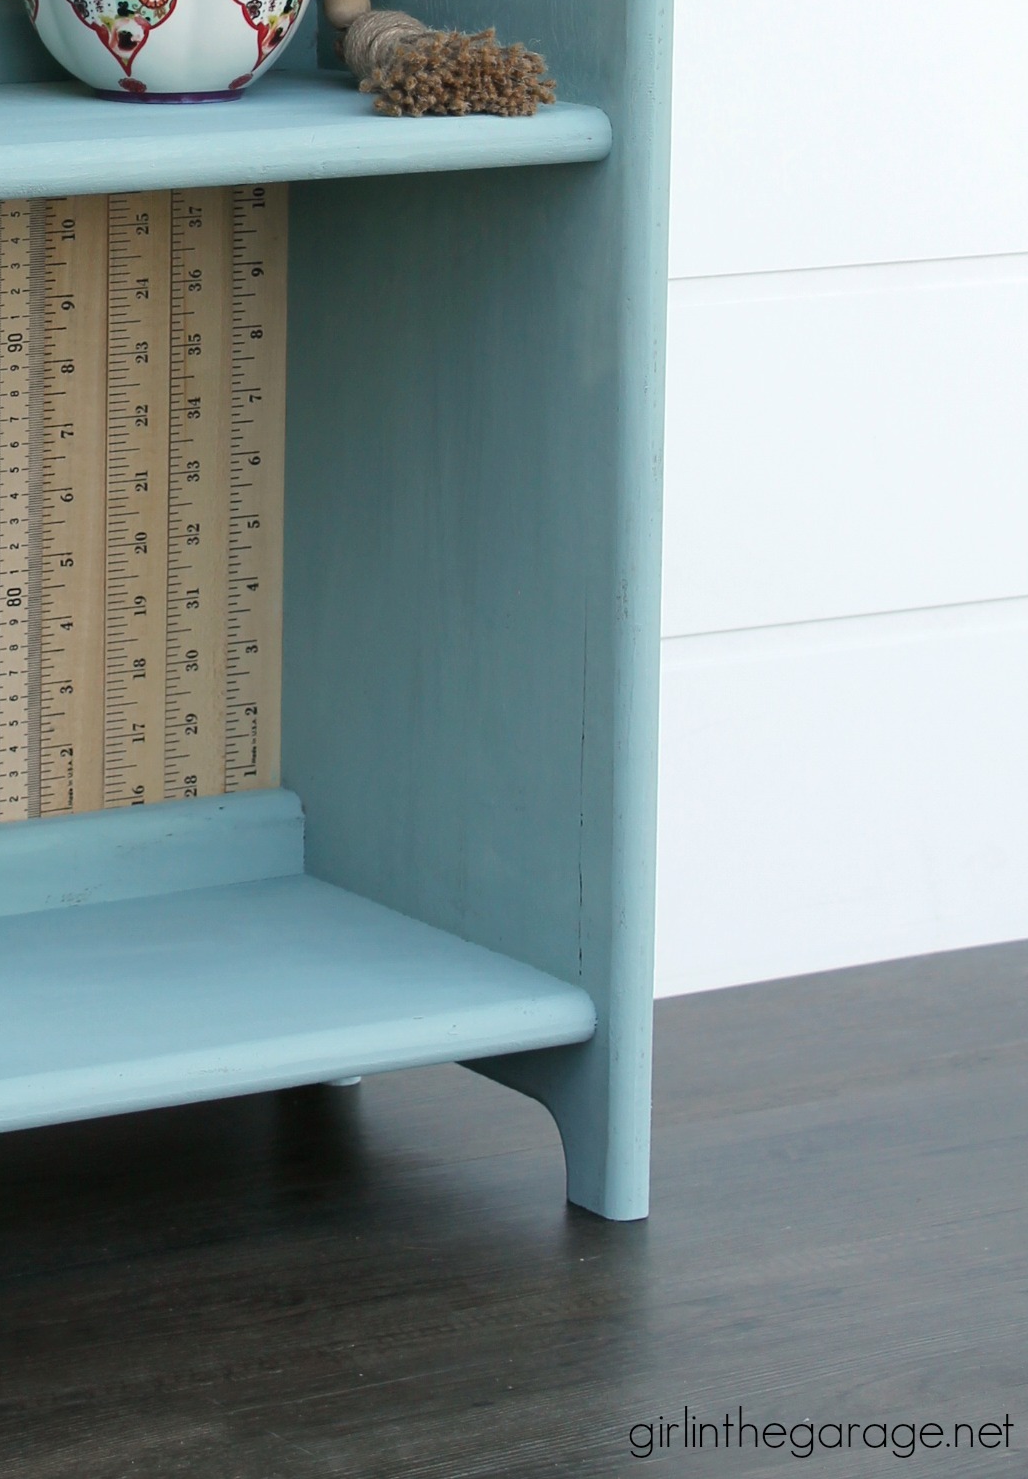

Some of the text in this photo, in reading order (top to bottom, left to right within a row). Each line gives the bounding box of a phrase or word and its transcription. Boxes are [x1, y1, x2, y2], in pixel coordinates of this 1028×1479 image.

[252, 187, 265, 208] 10
[62, 219, 76, 240] 10
[252, 267, 264, 277] 9
[61, 300, 75, 311] 9
[251, 329, 263, 339] 8
[8, 333, 23, 352] 90
[61, 364, 74, 374] 8
[250, 394, 262, 403] 7
[61, 430, 74, 438] 7
[248, 456, 261, 466] 6
[60, 492, 74, 502] 6
[184, 207, 202, 797] 28 29 30 31 32 33 34 35 36 37
[132, 212, 150, 805] 16 17 18 19 20 21 22 23 24 25
[248, 520, 260, 529] 5
[60, 558, 74, 567] 5
[246, 582, 259, 592] 4
[7, 588, 22, 606] 80
[60, 622, 74, 631] 4
[246, 644, 258, 654] 3
[60, 684, 74, 694] 3
[245, 706, 258, 716] 2
[60, 748, 73, 757] 2
